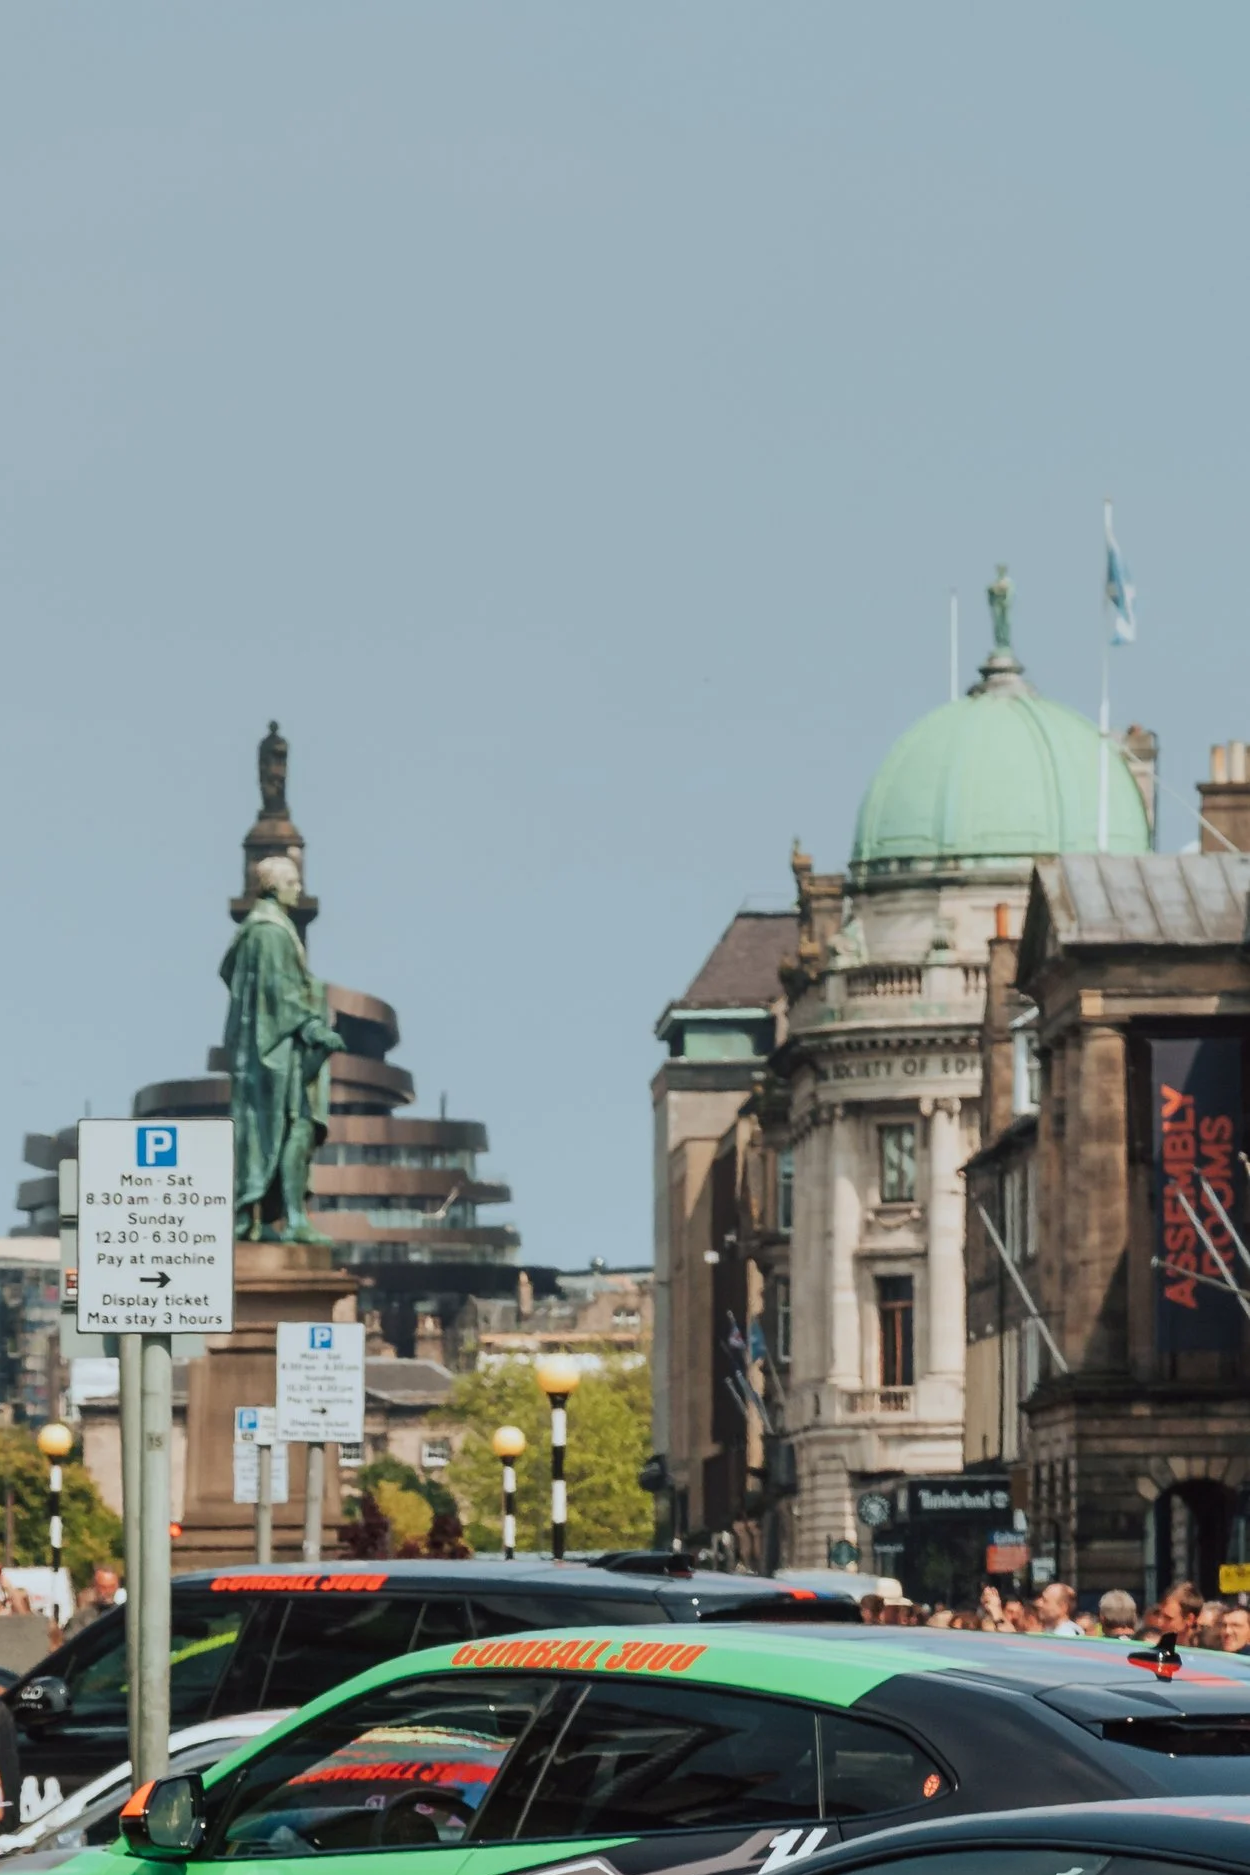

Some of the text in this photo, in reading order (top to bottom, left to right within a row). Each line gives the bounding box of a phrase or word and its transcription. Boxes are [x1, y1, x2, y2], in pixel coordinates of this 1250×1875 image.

[146, 1129, 173, 1165] P
[120, 1174, 153, 1187] Mon
[166, 1174, 193, 1187] Sat
[85, 1193, 123, 1205] 8.30
[127, 1195, 149, 1206] am
[163, 1193, 199, 1205] 6.30
[204, 1195, 227, 1208] pm
[1160, 1083, 1198, 1309] ASSEMBLY
[1200, 1115, 1235, 1277] ROOMS
[128, 1212, 185, 1228] Sunday
[96, 1231, 139, 1244] 12.30
[152, 1231, 189, 1244] 6.30
[193, 1234, 217, 1247] pm
[97, 1252, 215, 1268] Pay at machine
[102, 1294, 210, 1309] Display ticket
[87, 1312, 223, 1328] Max stay 3 hours
[210, 1575, 322, 1591] GUMBALL
[451, 1639, 709, 1672] GUMBALL 3000
